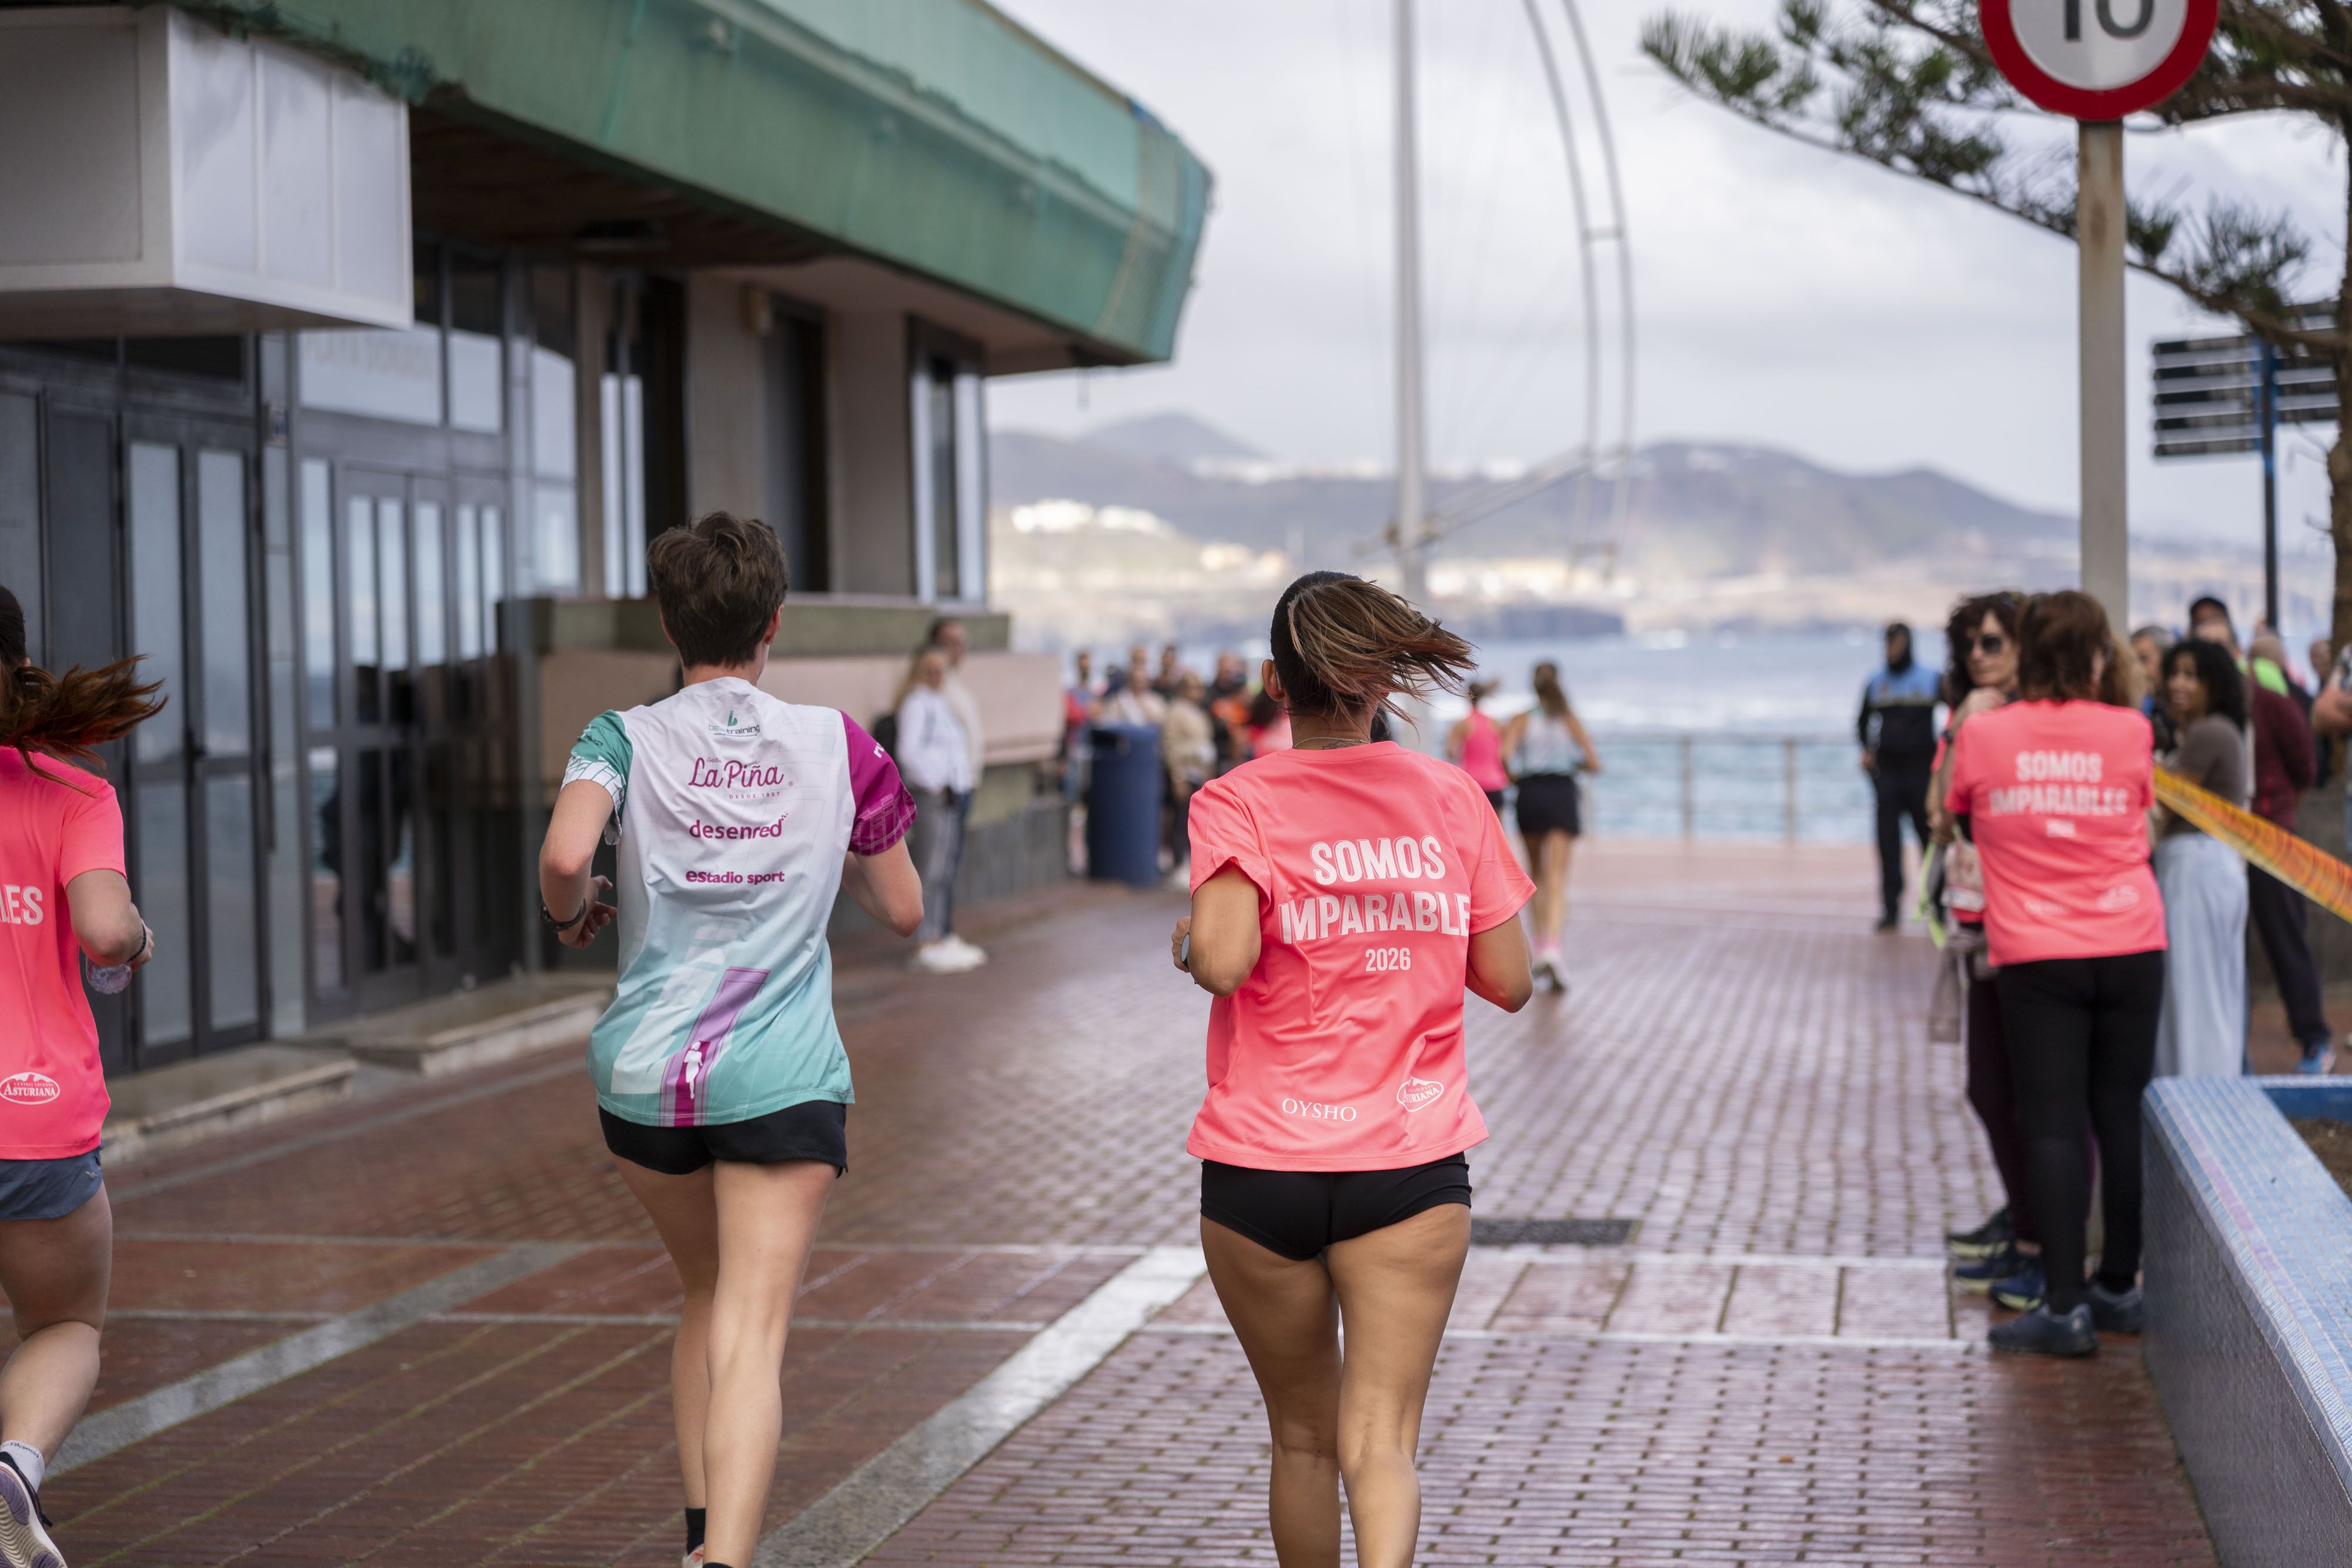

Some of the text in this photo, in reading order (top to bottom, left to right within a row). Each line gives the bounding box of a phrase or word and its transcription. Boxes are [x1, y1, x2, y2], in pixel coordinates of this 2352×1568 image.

[688, 757, 784, 788] La Piña
[2016, 750, 2103, 783] SOMOS
[1989, 785, 2128, 816] IMPARABLES
[689, 819, 782, 839] desenred
[1310, 835, 1445, 885] SOMOS
[686, 871, 785, 885] estadio sport
[1365, 947, 1411, 972] 2026
[3, 1082, 56, 1096] ASTURIANA
[1282, 1098, 1357, 1122] OYSHO
